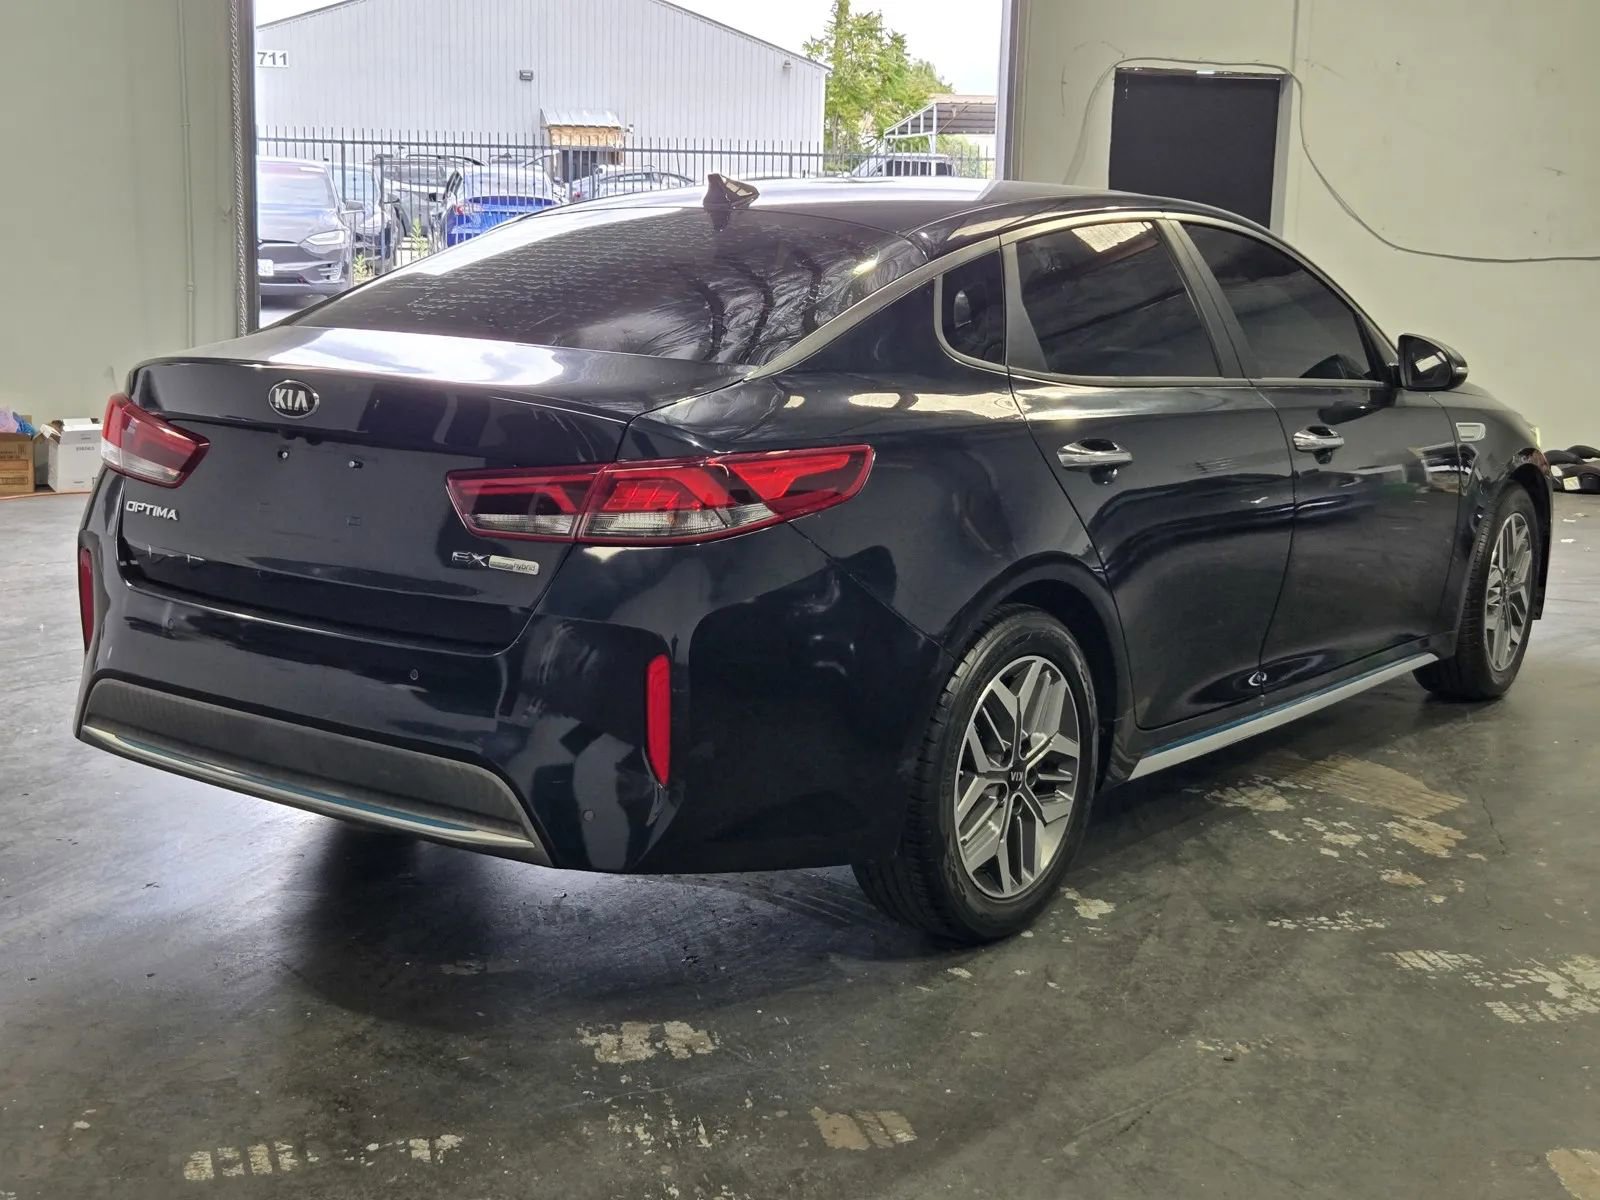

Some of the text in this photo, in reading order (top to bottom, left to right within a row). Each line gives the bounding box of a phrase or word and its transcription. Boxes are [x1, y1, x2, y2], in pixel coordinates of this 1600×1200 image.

[257, 51, 287, 66] 711
[275, 388, 309, 411] KIA
[126, 501, 178, 520] OPTIMA
[452, 552, 488, 566] EX
